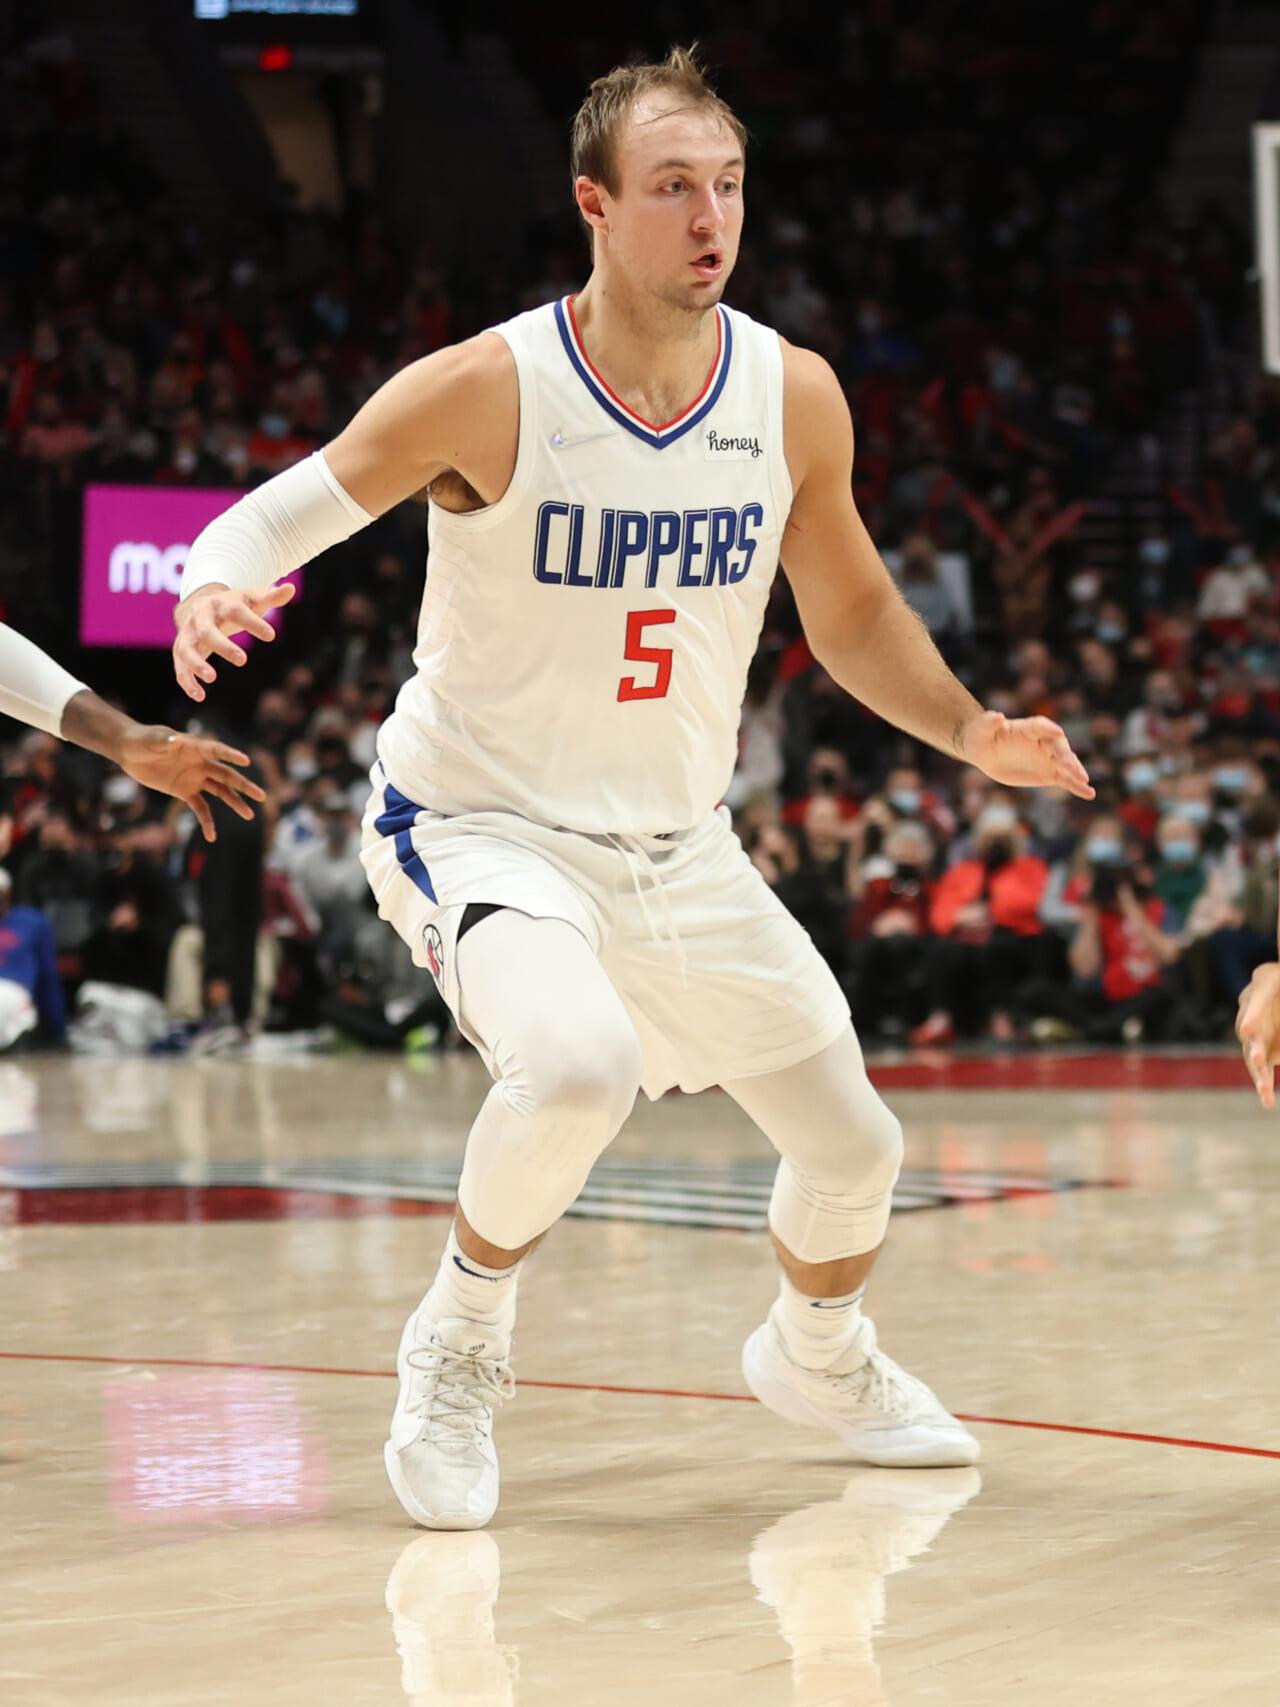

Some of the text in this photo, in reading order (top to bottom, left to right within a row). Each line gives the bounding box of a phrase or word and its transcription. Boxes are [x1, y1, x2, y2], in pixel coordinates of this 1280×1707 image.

[706, 430, 763, 458] honey
[533, 500, 764, 588] CLIPPERS
[617, 608, 677, 703] 5
